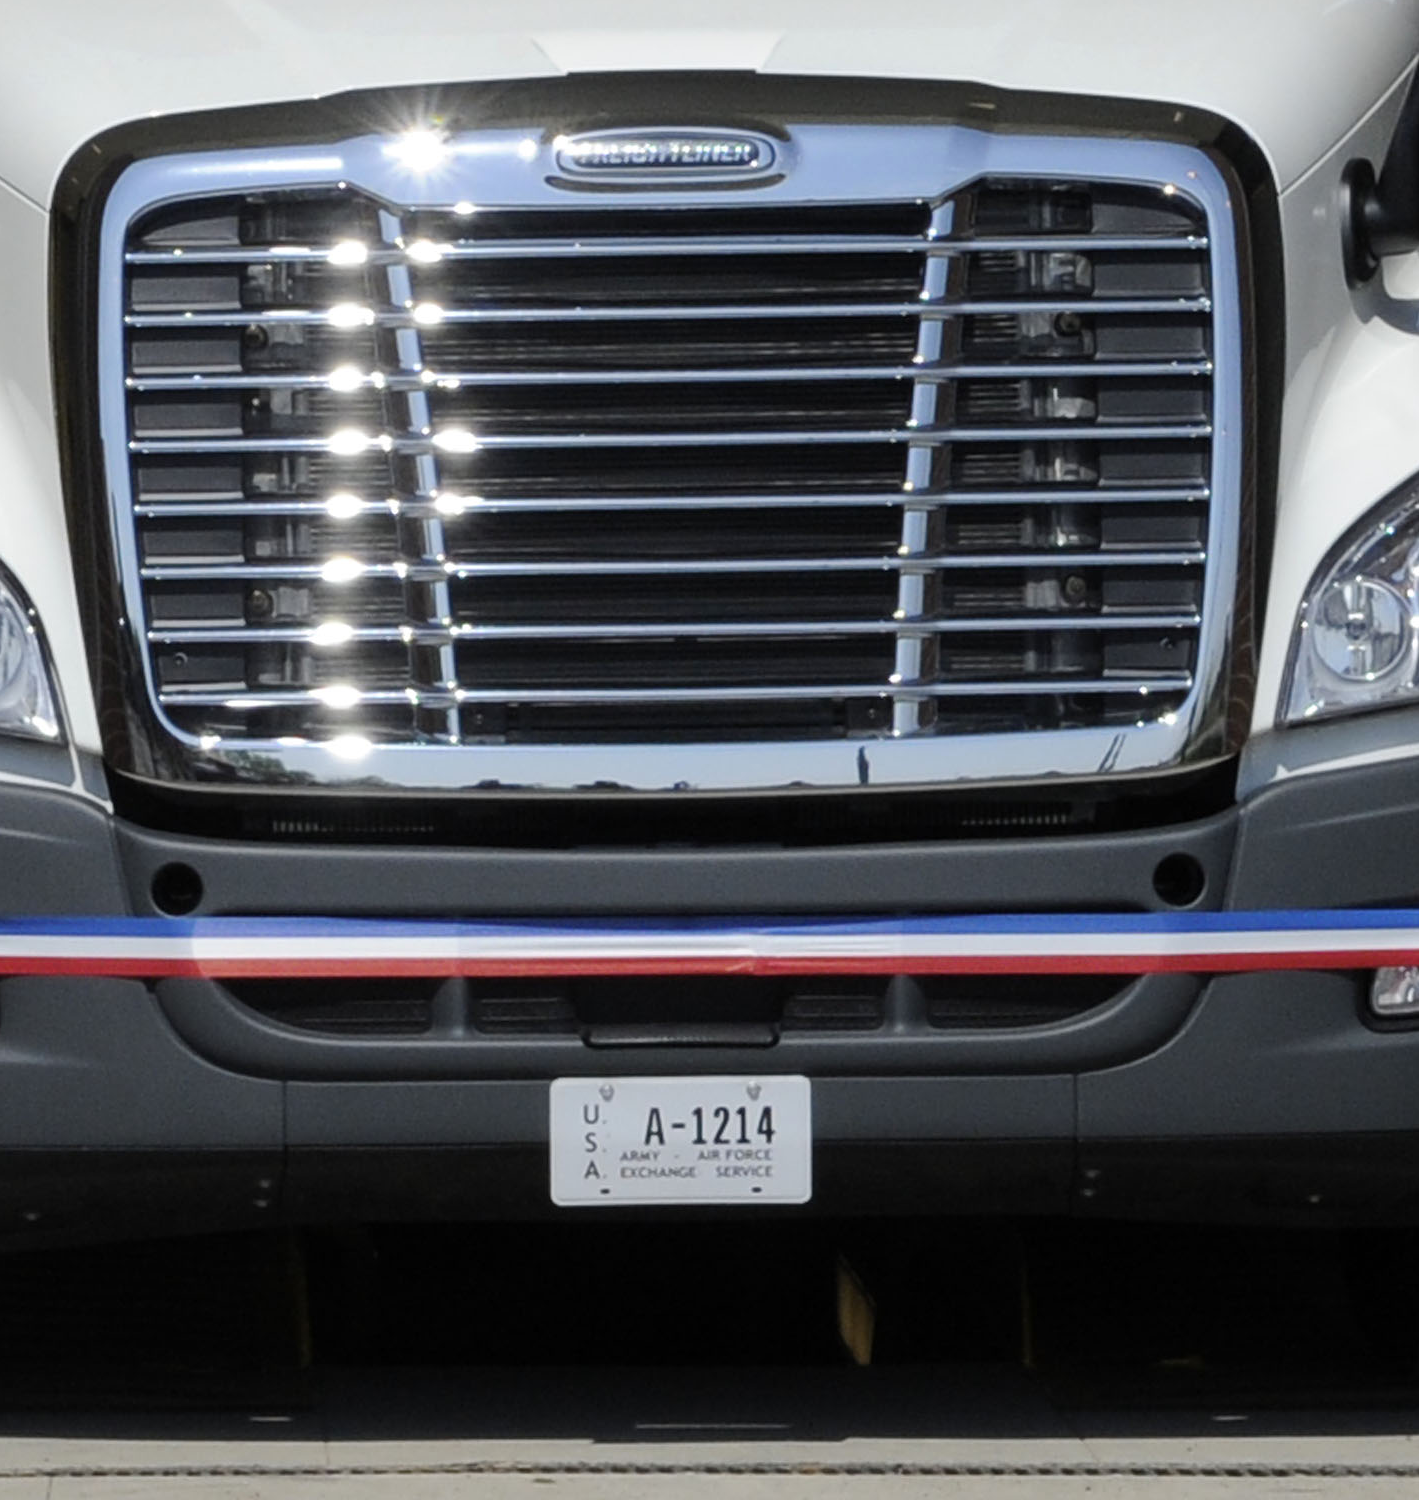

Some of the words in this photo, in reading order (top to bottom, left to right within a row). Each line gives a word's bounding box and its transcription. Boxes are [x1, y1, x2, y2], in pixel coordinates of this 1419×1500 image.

[644, 1106, 776, 1146] A-1214
[620, 1151, 661, 1162] ARMY
[697, 1150, 722, 1161] AIR
[726, 1150, 773, 1161] FORCE
[620, 1167, 697, 1179] EXCHANGE
[715, 1166, 773, 1178] SERVICE
